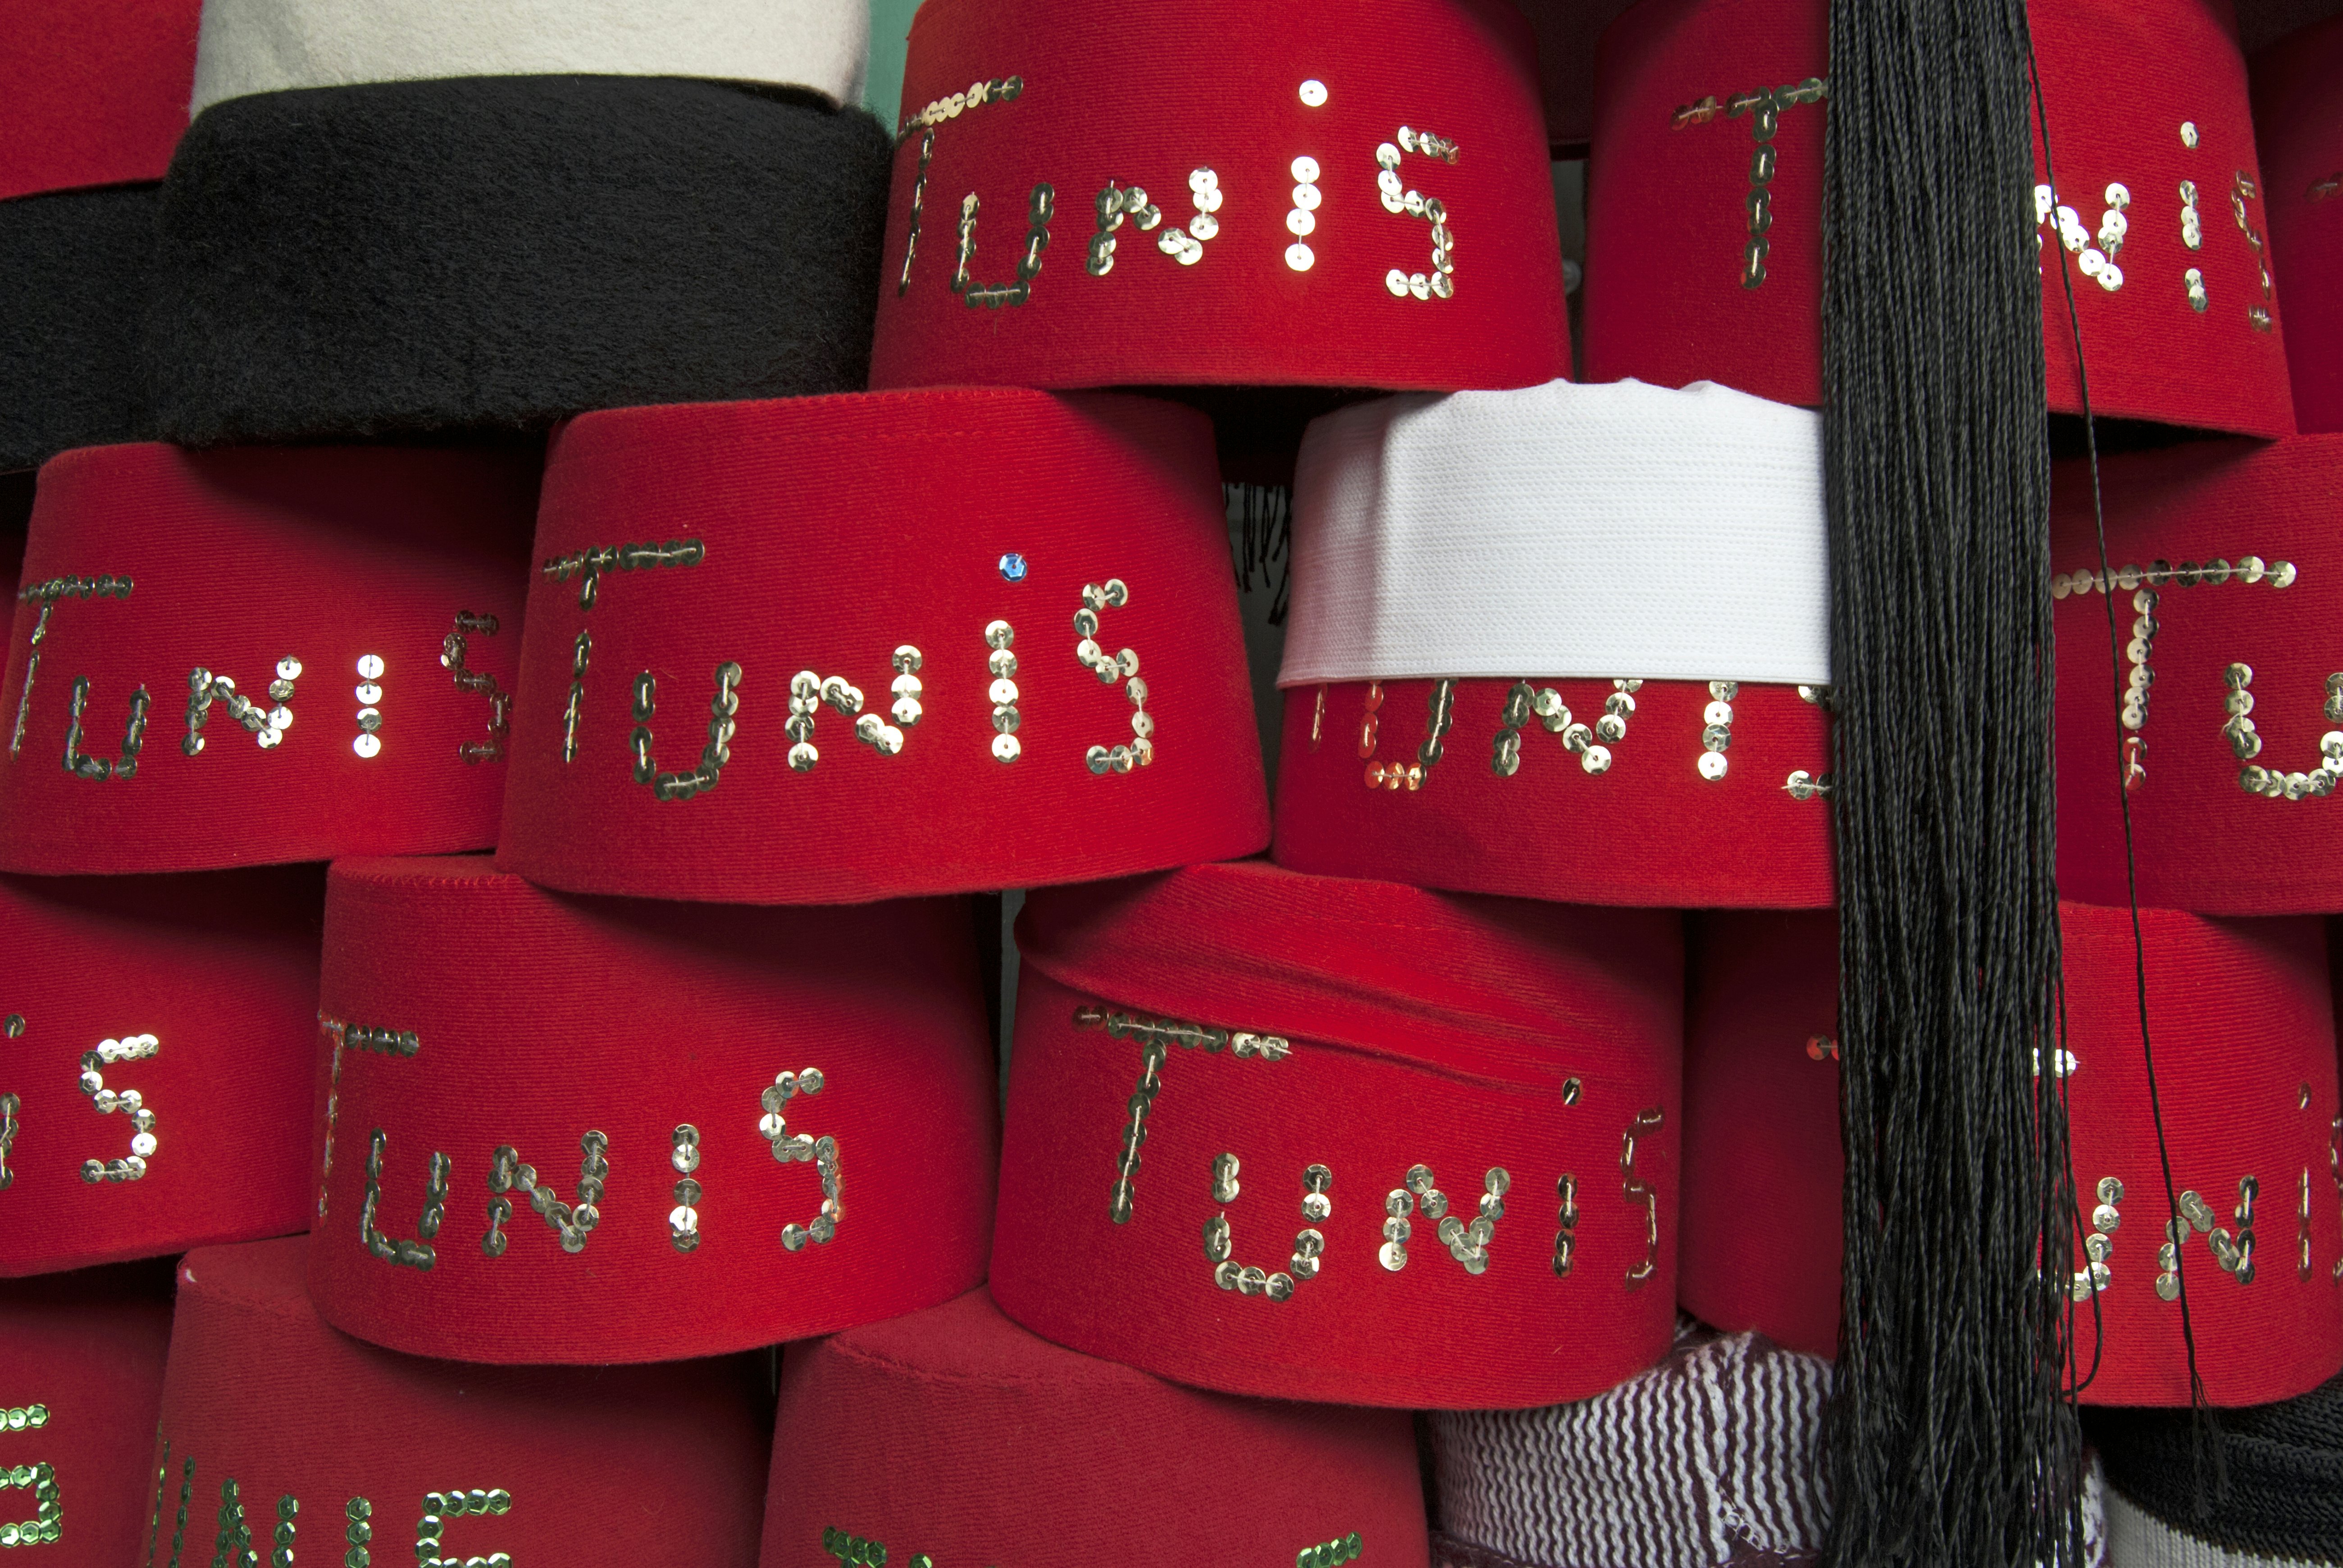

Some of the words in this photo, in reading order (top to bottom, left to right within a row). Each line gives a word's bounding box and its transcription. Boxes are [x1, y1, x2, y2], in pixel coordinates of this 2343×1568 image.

[1670, 77, 2272, 334] TNiS
[10, 573, 510, 782] TUNIS
[317, 1010, 846, 1271] TUNIS
